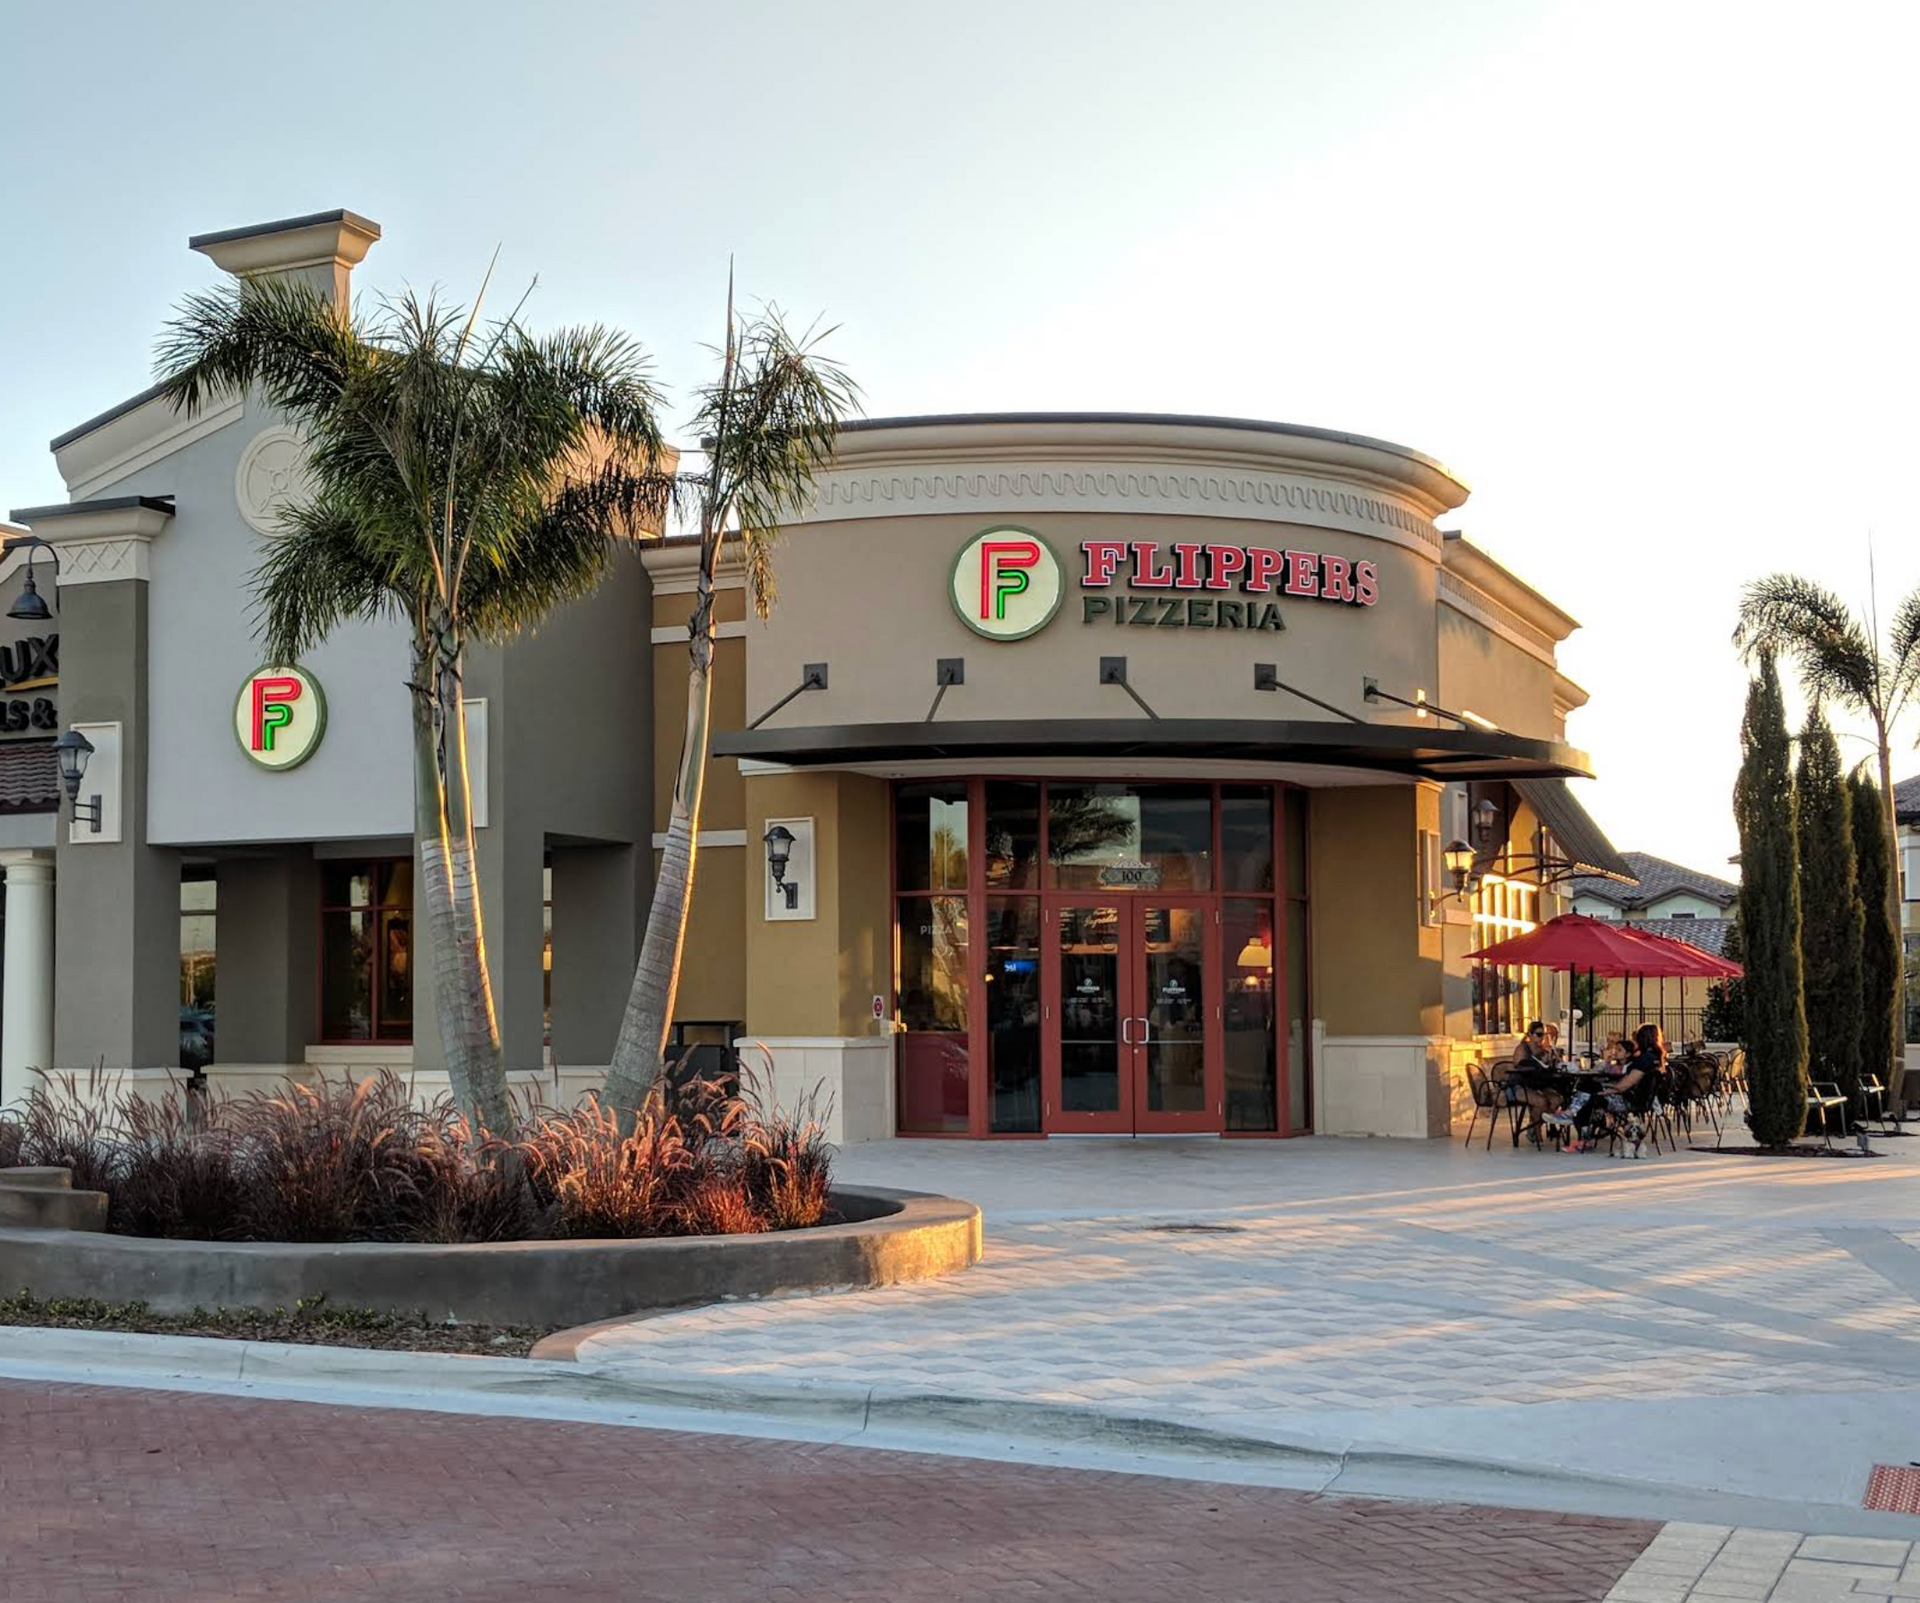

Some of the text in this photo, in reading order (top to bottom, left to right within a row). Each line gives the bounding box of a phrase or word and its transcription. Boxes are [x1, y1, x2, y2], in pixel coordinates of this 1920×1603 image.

[1081, 541, 1379, 606] FLIPPERS
[1083, 596, 1287, 630] PIZZERIA
[0, 633, 59, 689] UX
[1121, 870, 1142, 881] 100
[920, 925, 952, 935] PIZZA
